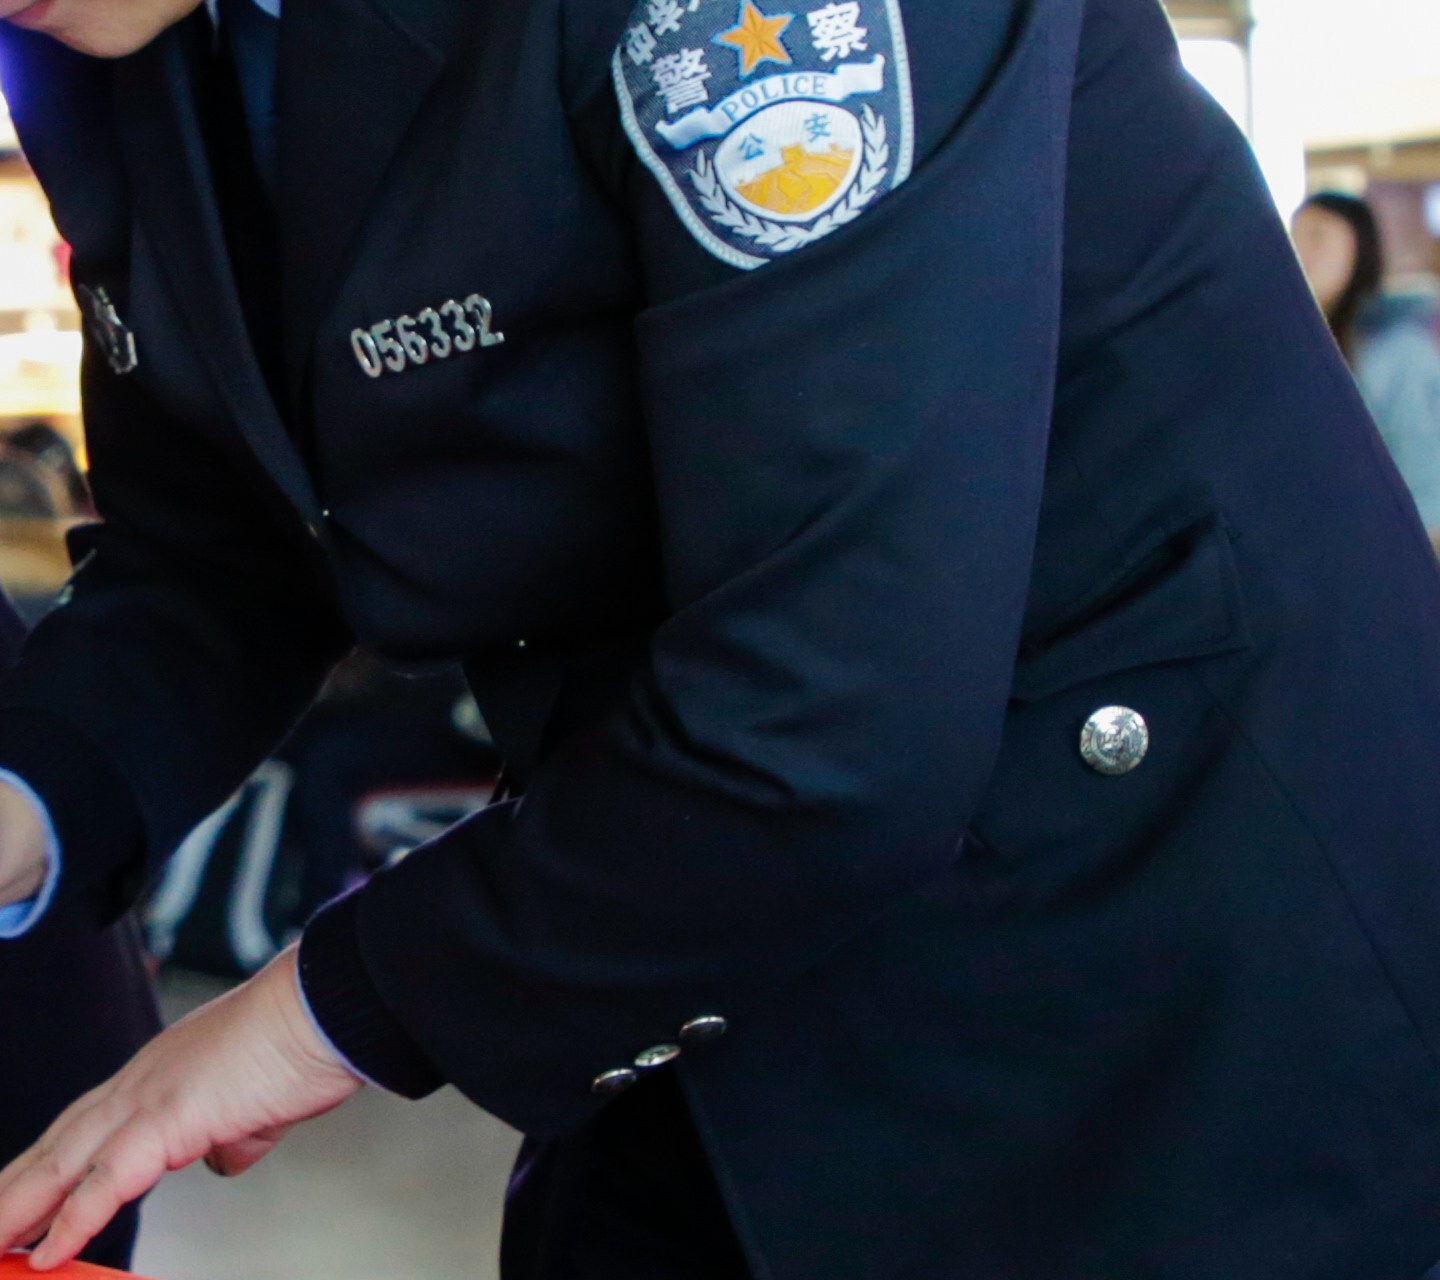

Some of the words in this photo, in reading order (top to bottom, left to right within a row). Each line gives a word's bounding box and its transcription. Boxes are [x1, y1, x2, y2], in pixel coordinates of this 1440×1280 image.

[721, 75, 827, 122] POLICE
[738, 114, 831, 160] 公安
[351, 293, 504, 377] 056332
